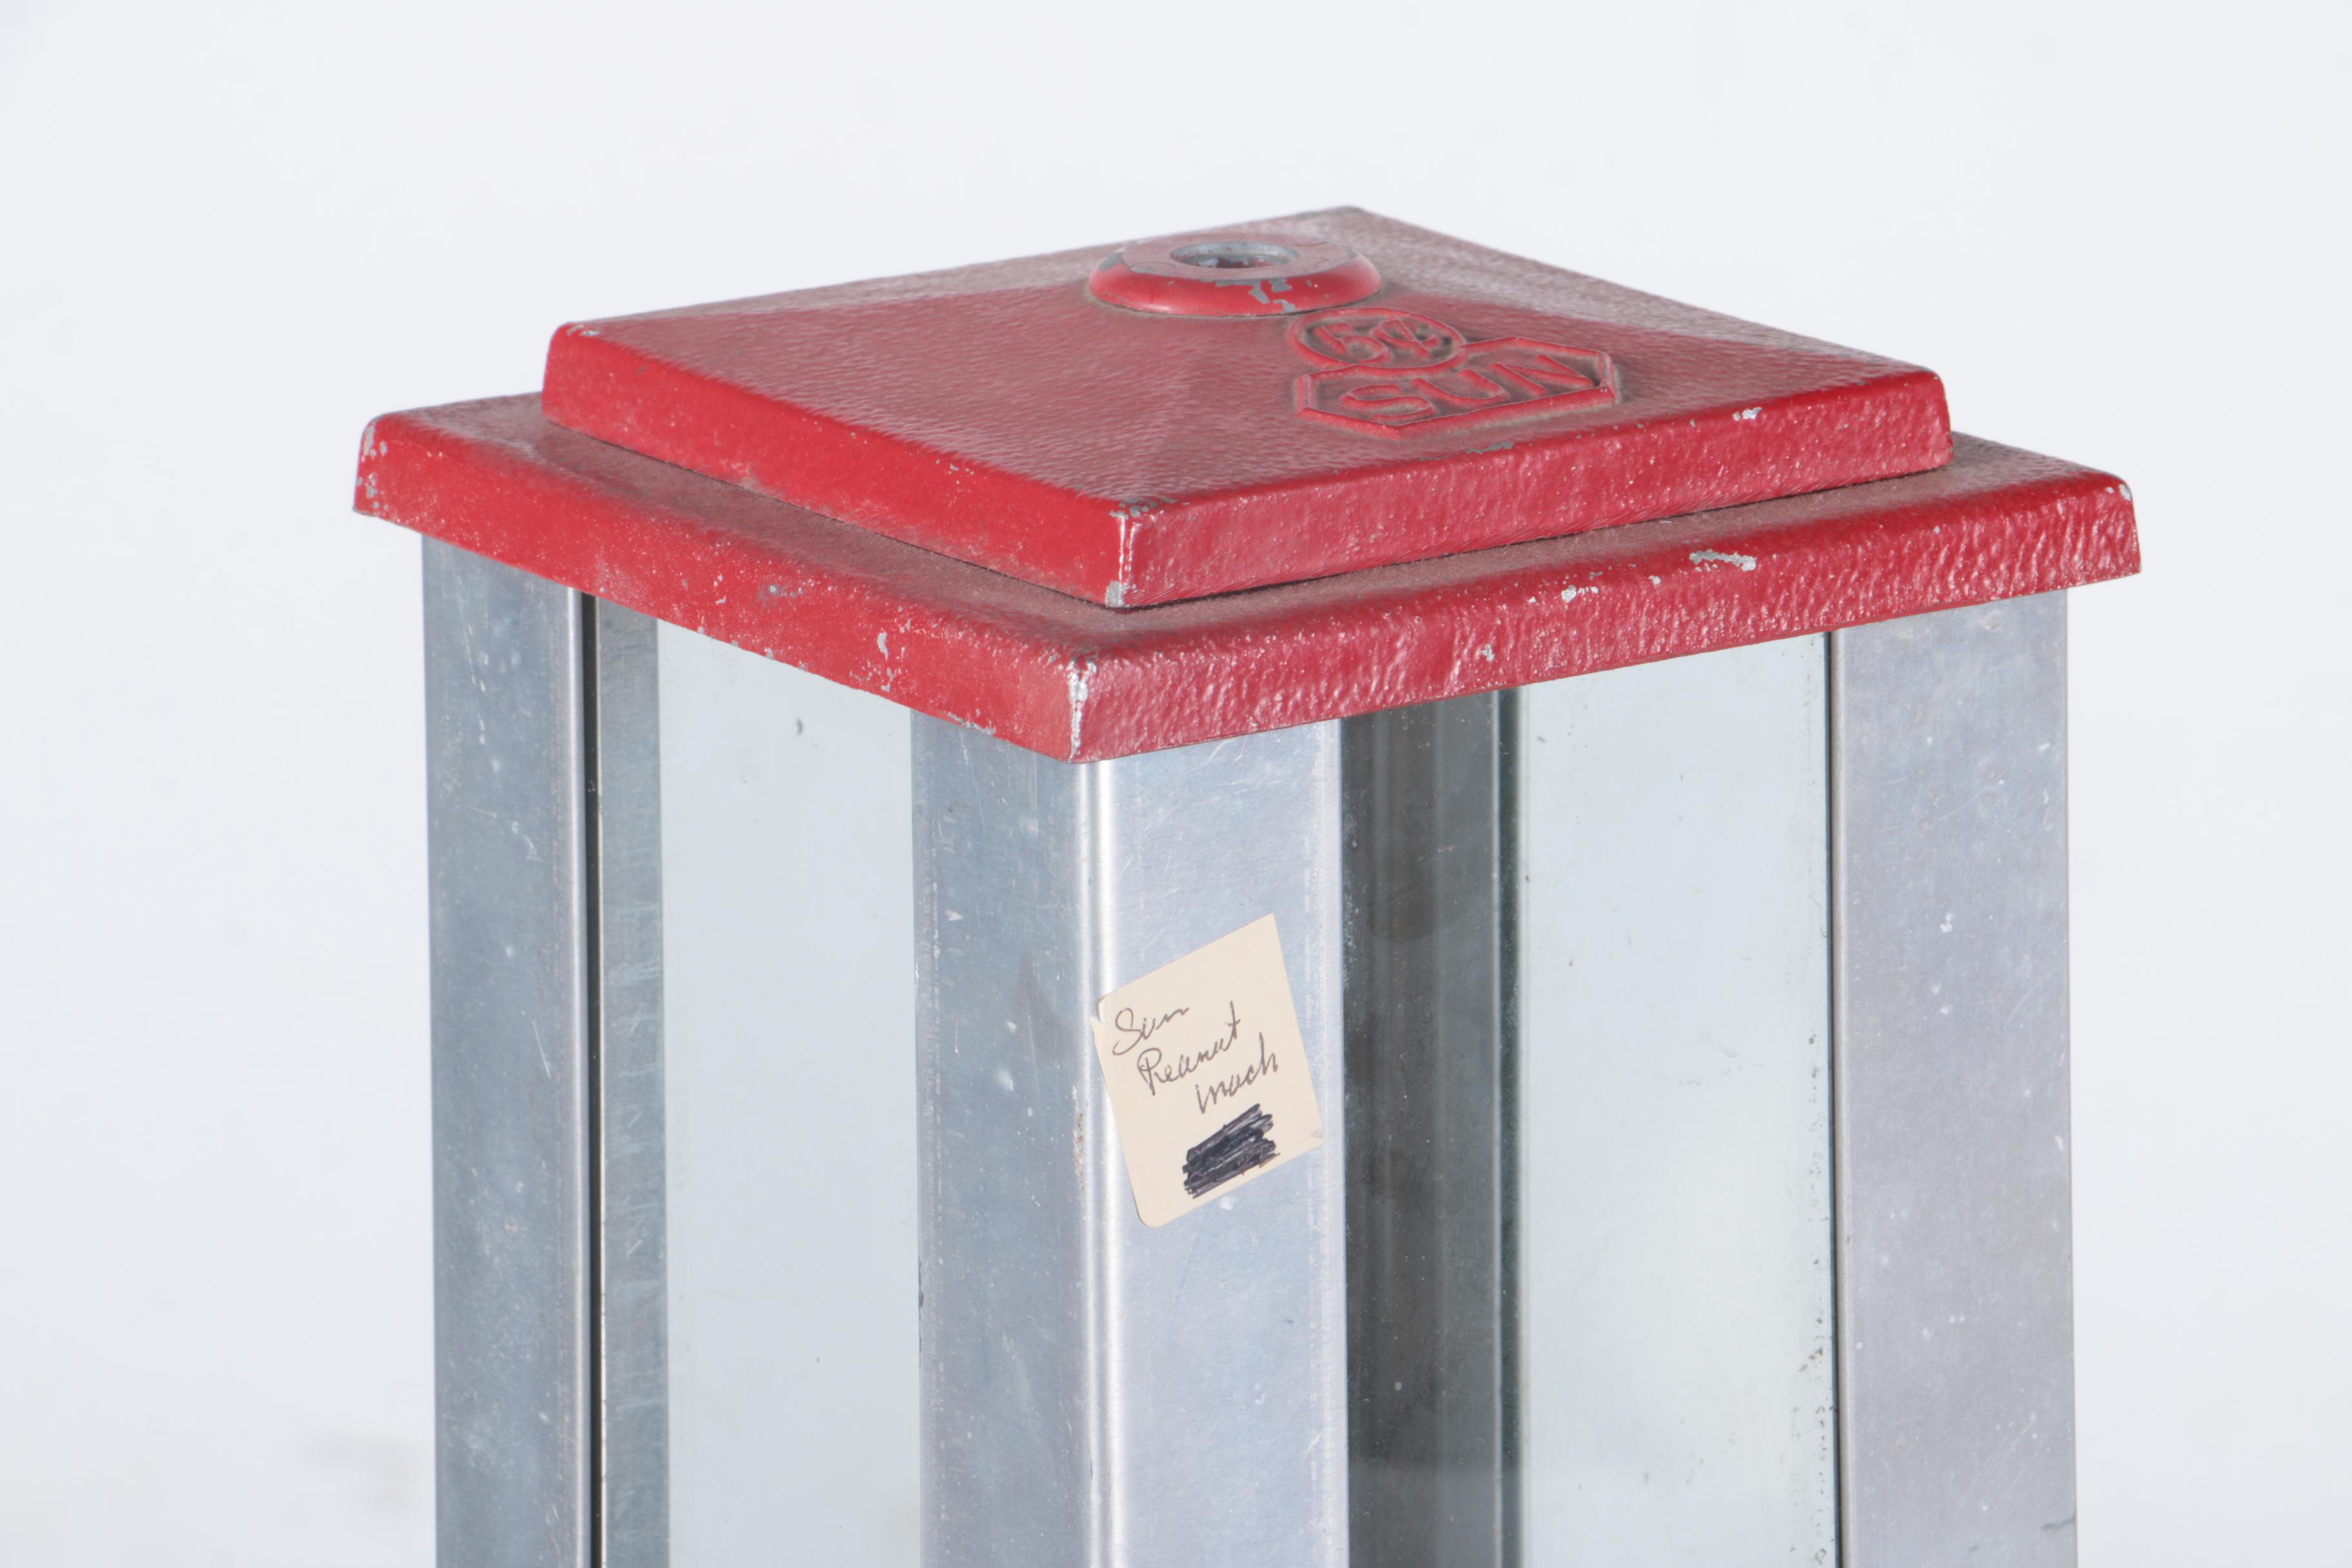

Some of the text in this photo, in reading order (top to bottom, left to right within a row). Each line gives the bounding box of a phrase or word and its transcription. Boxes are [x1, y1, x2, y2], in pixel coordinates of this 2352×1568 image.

[1340, 354, 1594, 424] SUN
[1112, 1007, 1190, 1056] Sun
[1137, 1000, 1241, 1097] Peanut
